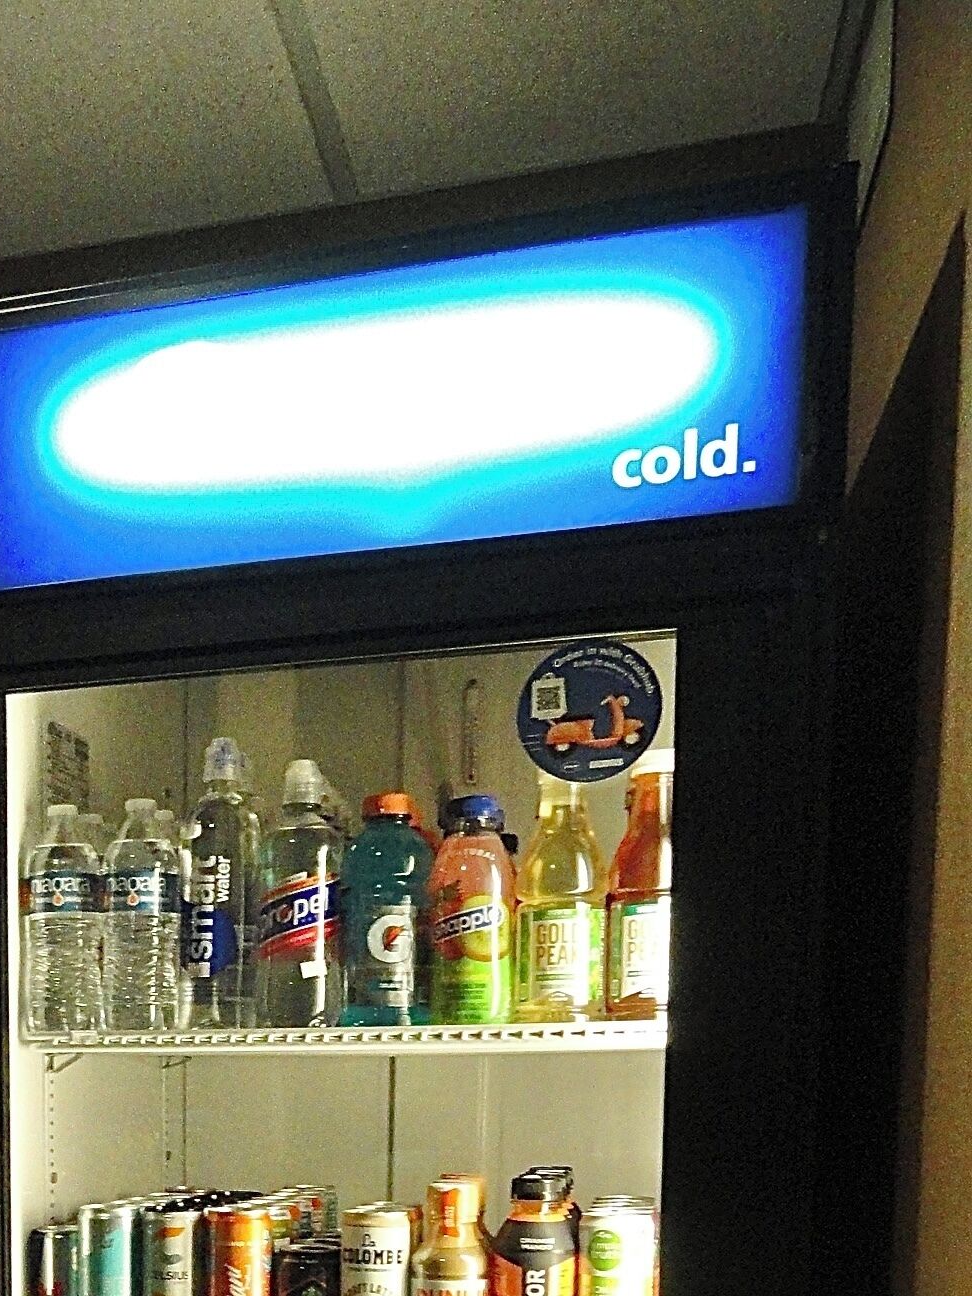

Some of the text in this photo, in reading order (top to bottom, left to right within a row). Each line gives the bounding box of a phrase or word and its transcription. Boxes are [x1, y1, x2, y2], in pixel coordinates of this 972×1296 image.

[612, 422, 757, 488] cold.
[191, 855, 216, 960] smart
[216, 855, 231, 903] water
